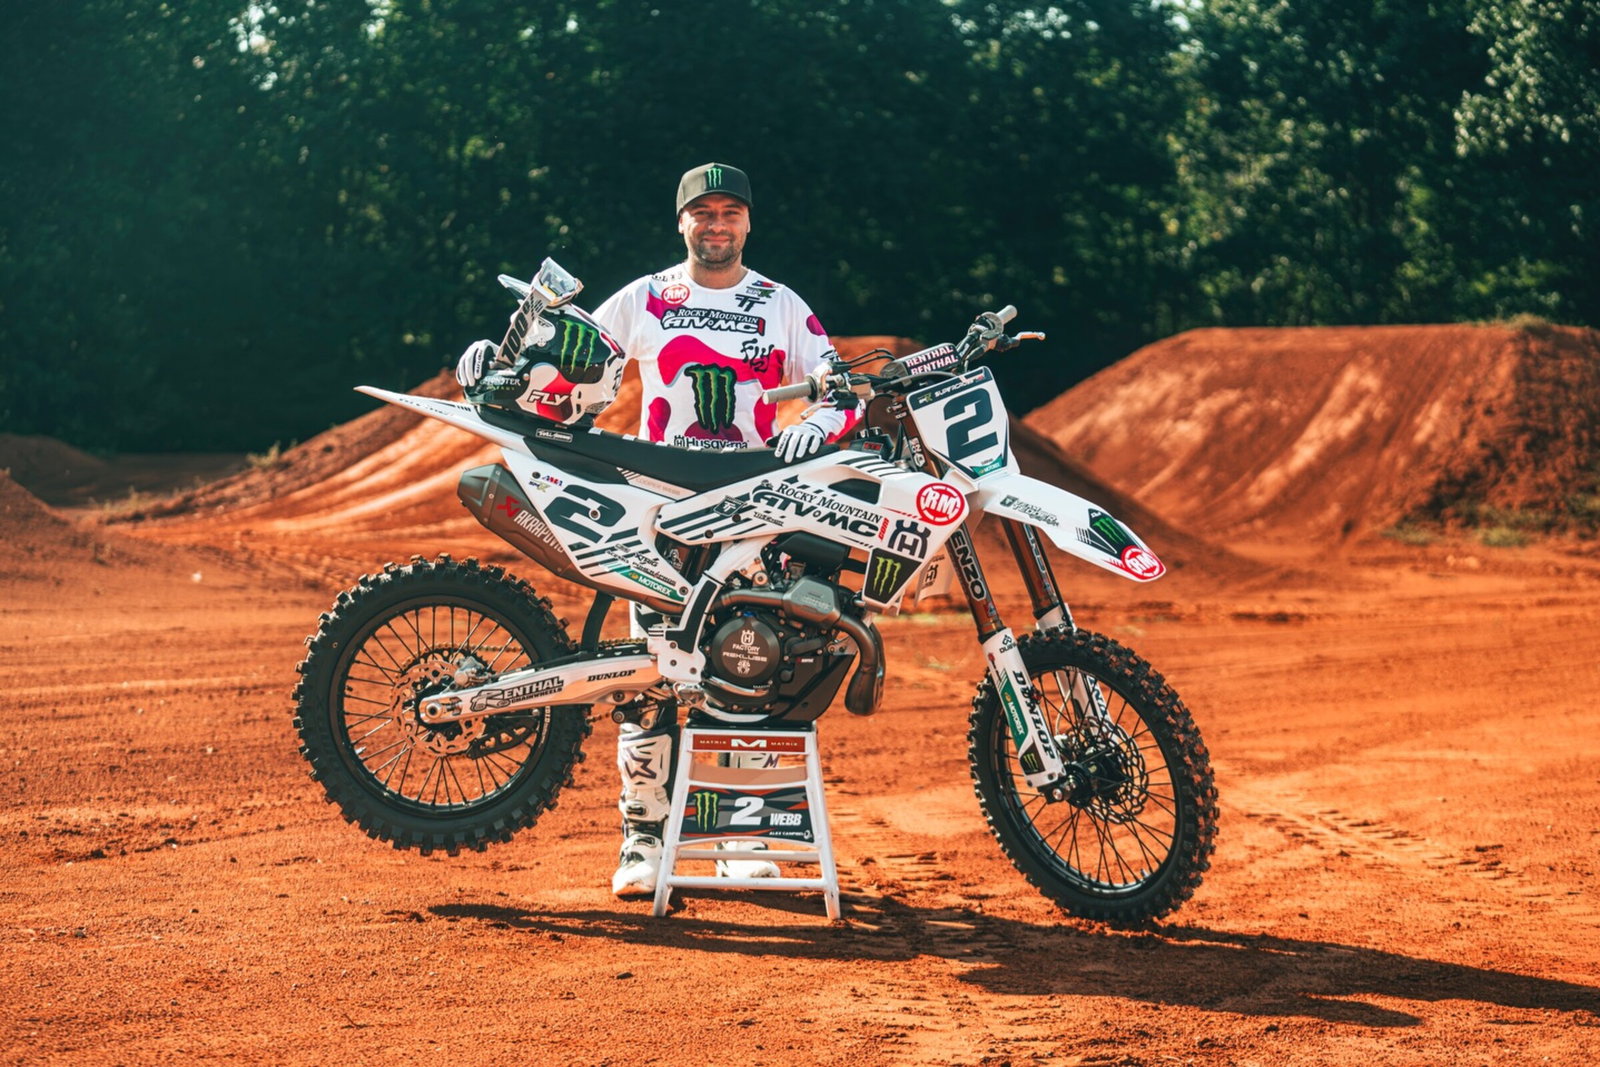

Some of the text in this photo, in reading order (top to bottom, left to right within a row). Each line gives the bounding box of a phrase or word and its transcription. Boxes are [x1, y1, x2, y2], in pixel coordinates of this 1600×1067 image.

[677, 308, 759, 324] ROCKY MOUNTAIN
[905, 345, 954, 368] RENTHAL
[911, 355, 959, 376] RENTHAL
[527, 389, 571, 407] FLY
[943, 387, 999, 462] 2
[686, 437, 749, 449] Husqvarna
[544, 484, 626, 544] 2
[776, 483, 818, 504] ROCKY
[817, 496, 883, 524] MOUNTAIN
[950, 530, 987, 601] ENZO
[638, 575, 673, 597] MOTOREX
[732, 643, 761, 652] FACTORY
[586, 669, 637, 682] DUNLOP
[1008, 701, 1026, 735] MOTOREX
[729, 796, 803, 826] 2 WEBB
